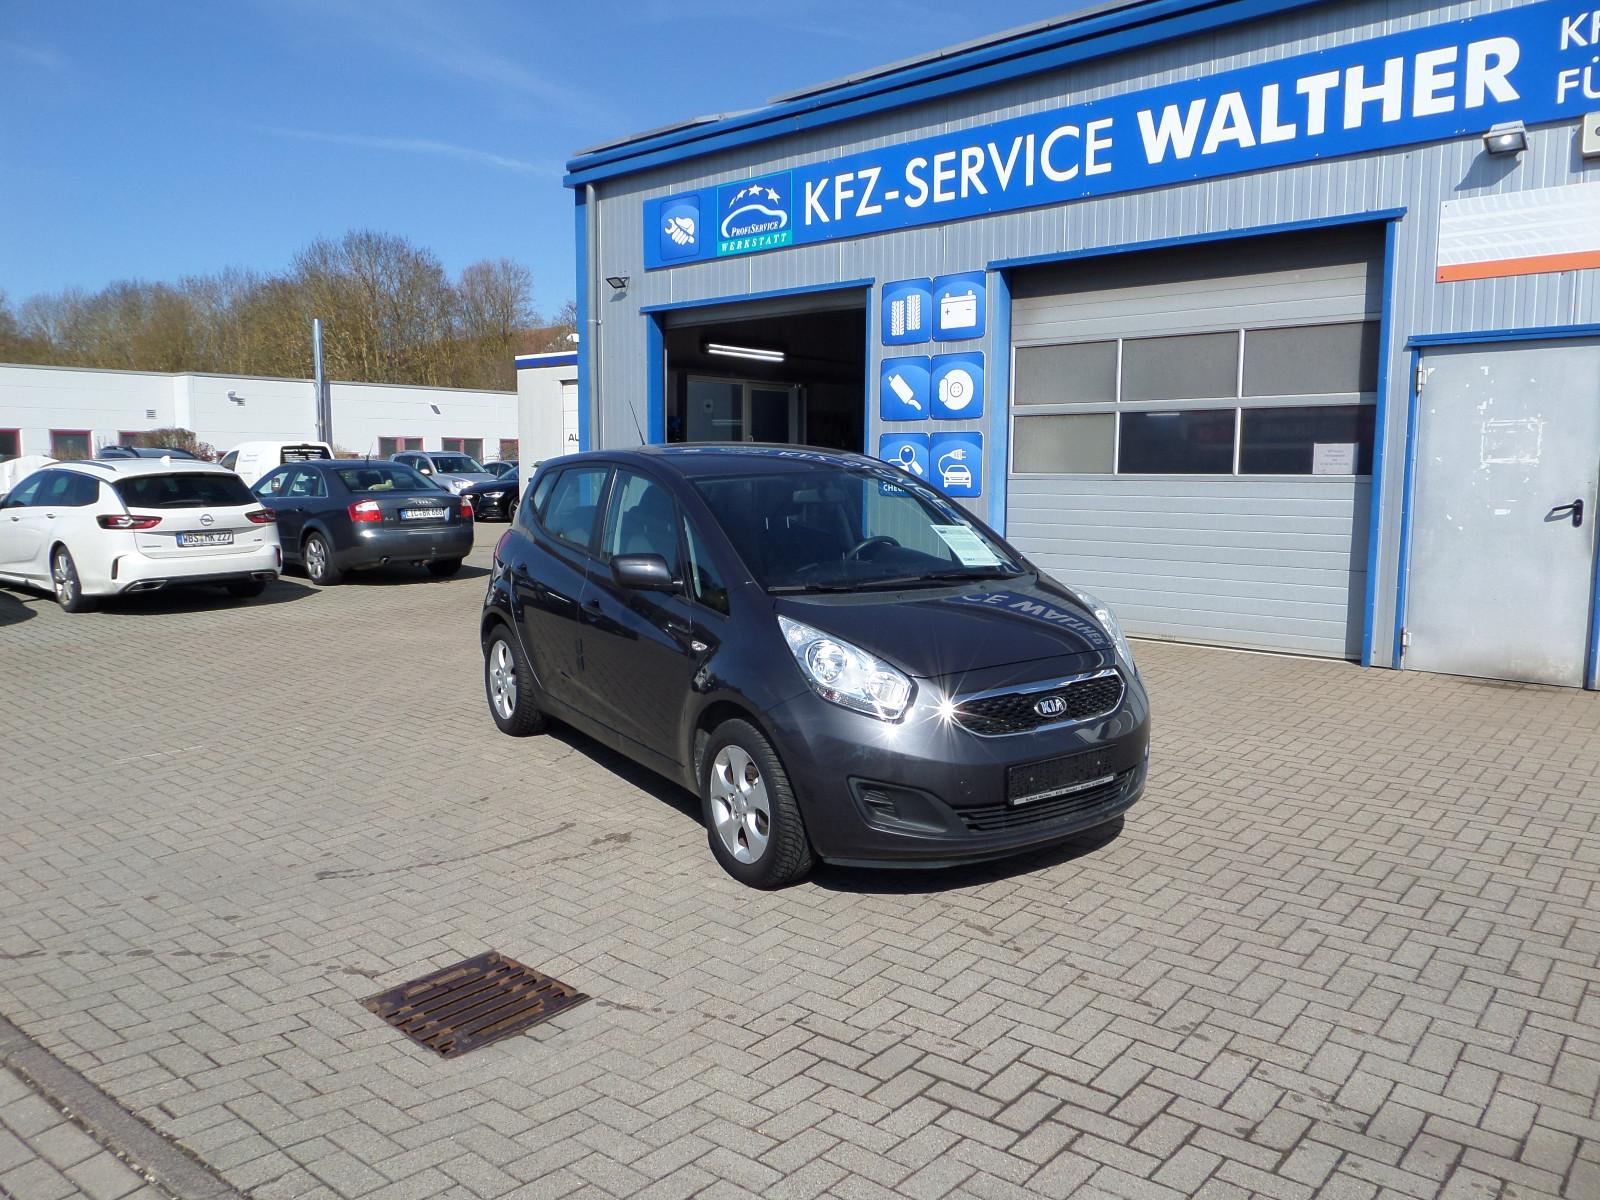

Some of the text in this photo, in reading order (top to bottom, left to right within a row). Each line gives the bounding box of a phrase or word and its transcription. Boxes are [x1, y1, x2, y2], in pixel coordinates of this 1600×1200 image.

[804, 36, 1521, 226] KFZ-SERVICE WALTHER
[721, 233, 787, 252] WERKSTATT
[183, 533, 199, 544] WBS
[204, 532, 215, 543] MK
[1040, 699, 1064, 714] KIA
